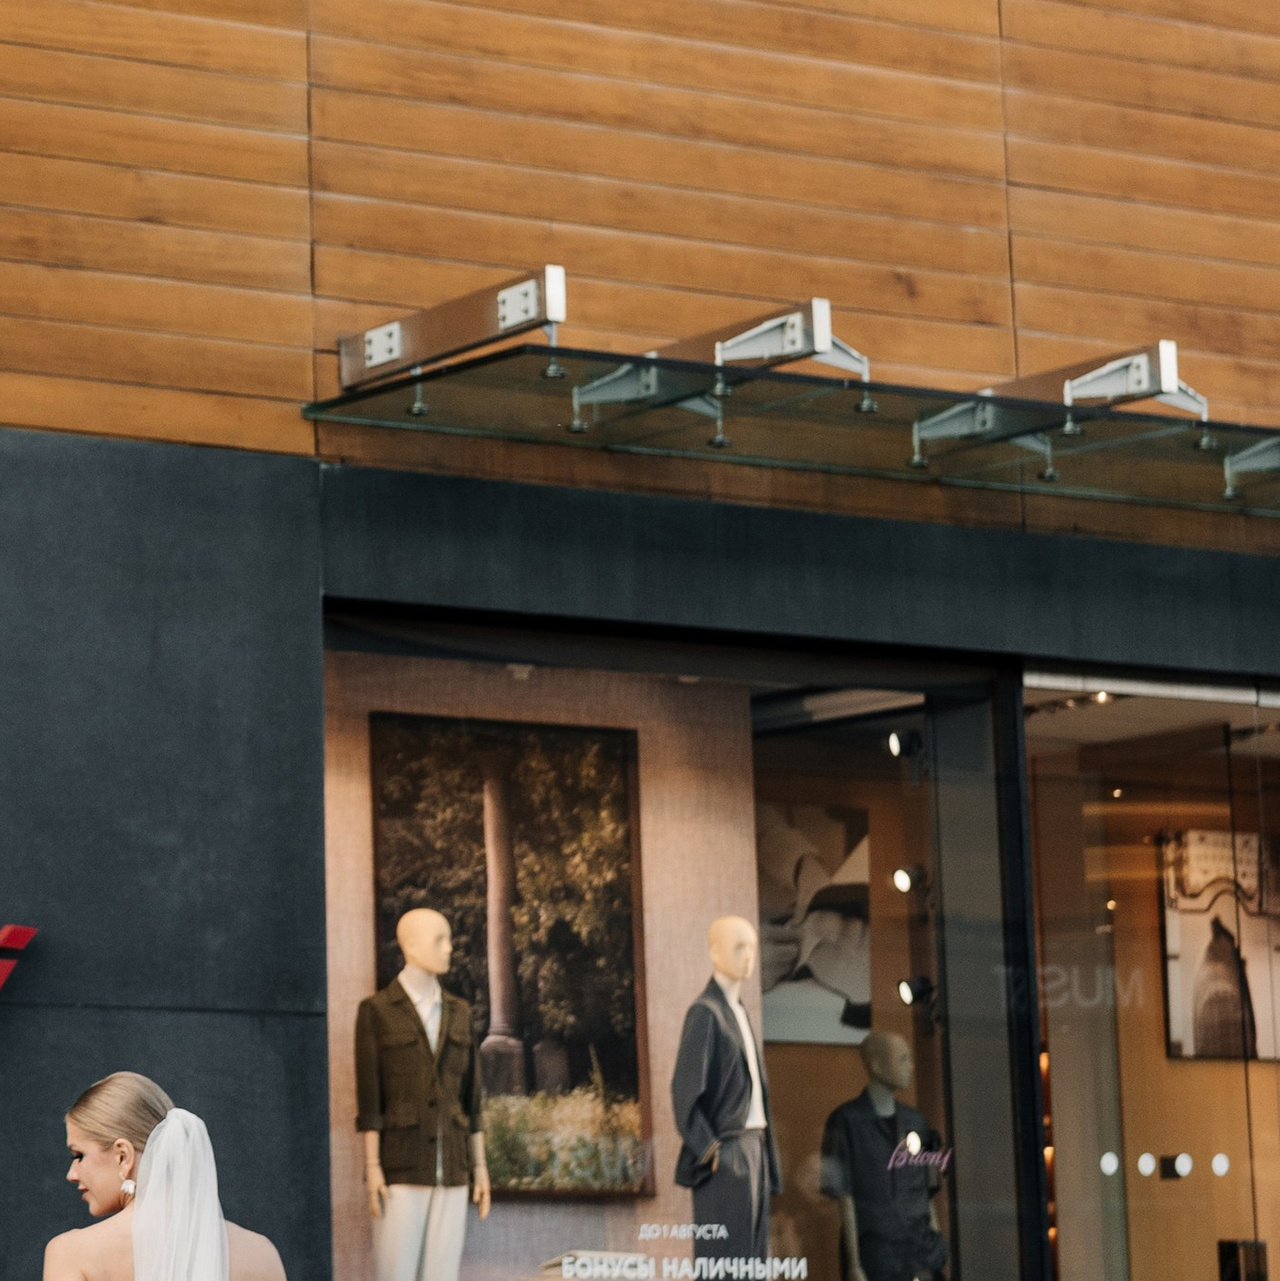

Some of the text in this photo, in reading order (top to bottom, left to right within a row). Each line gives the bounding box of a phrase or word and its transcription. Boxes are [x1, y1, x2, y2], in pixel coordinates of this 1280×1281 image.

[638, 1223, 661, 1241] ДО
[670, 1223, 729, 1241] АВГУСТА
[561, 1256, 808, 1281] БОНУСЫ НАЛИЧНЫМИ
